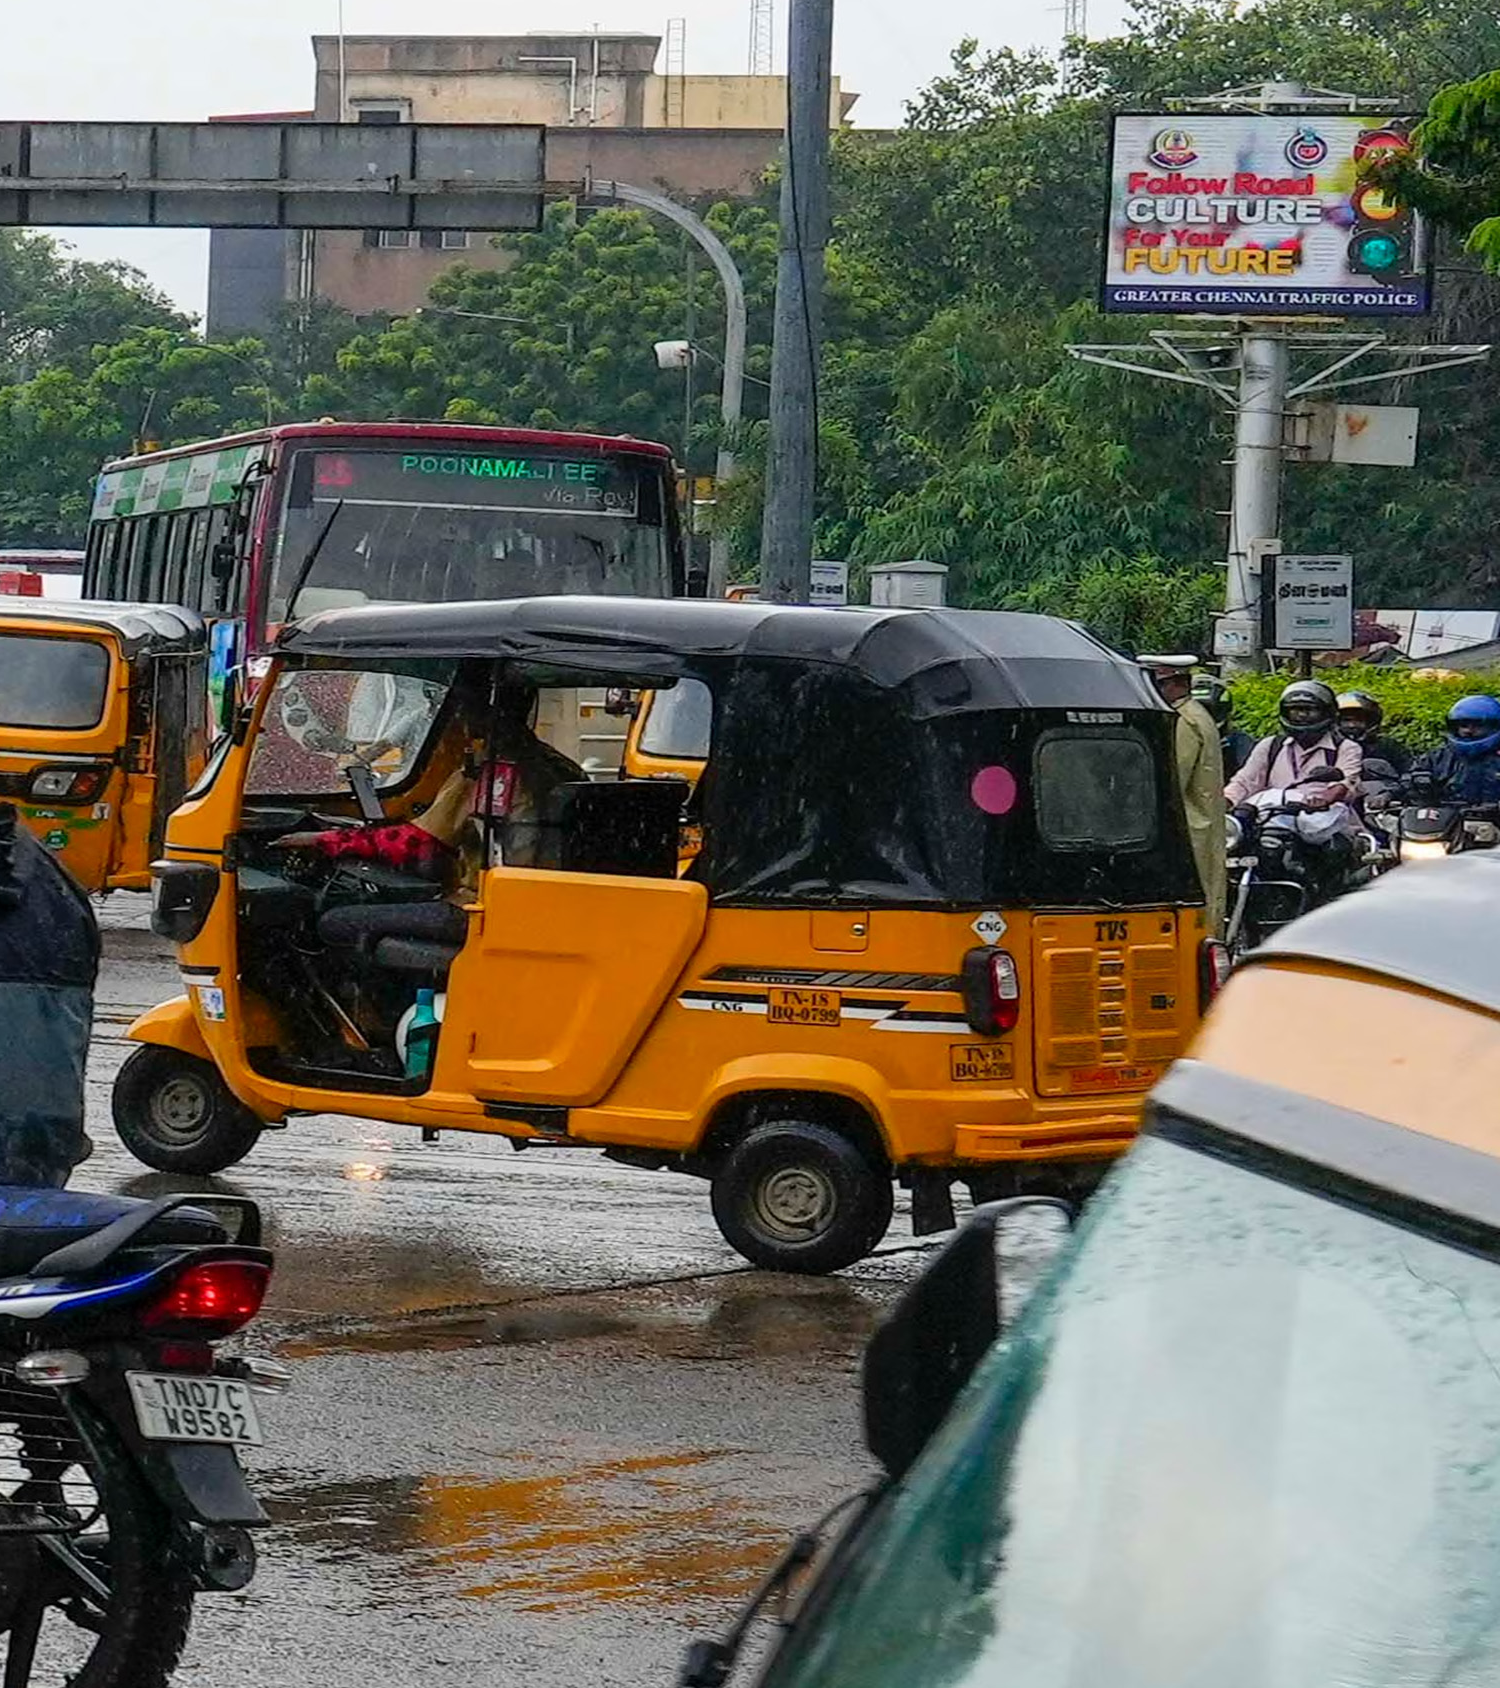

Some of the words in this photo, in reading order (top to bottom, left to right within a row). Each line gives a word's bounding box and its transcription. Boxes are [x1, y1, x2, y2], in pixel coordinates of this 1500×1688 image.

[1128, 171, 1227, 195] Follow
[1233, 171, 1317, 195] Road
[1126, 198, 1323, 224] CULTURE
[1126, 228, 1167, 246] For
[1171, 228, 1229, 247] Your
[1124, 247, 1296, 277] FUTURE
[1114, 290, 1192, 305] GREATER
[1195, 291, 1278, 306] CHENNAI
[1279, 292, 1352, 306] TRAFFIC
[1353, 293, 1418, 306] POLICE
[976, 919, 1001, 932] CNG
[1095, 921, 1128, 941] TVS
[711, 1001, 743, 1012] CNG
